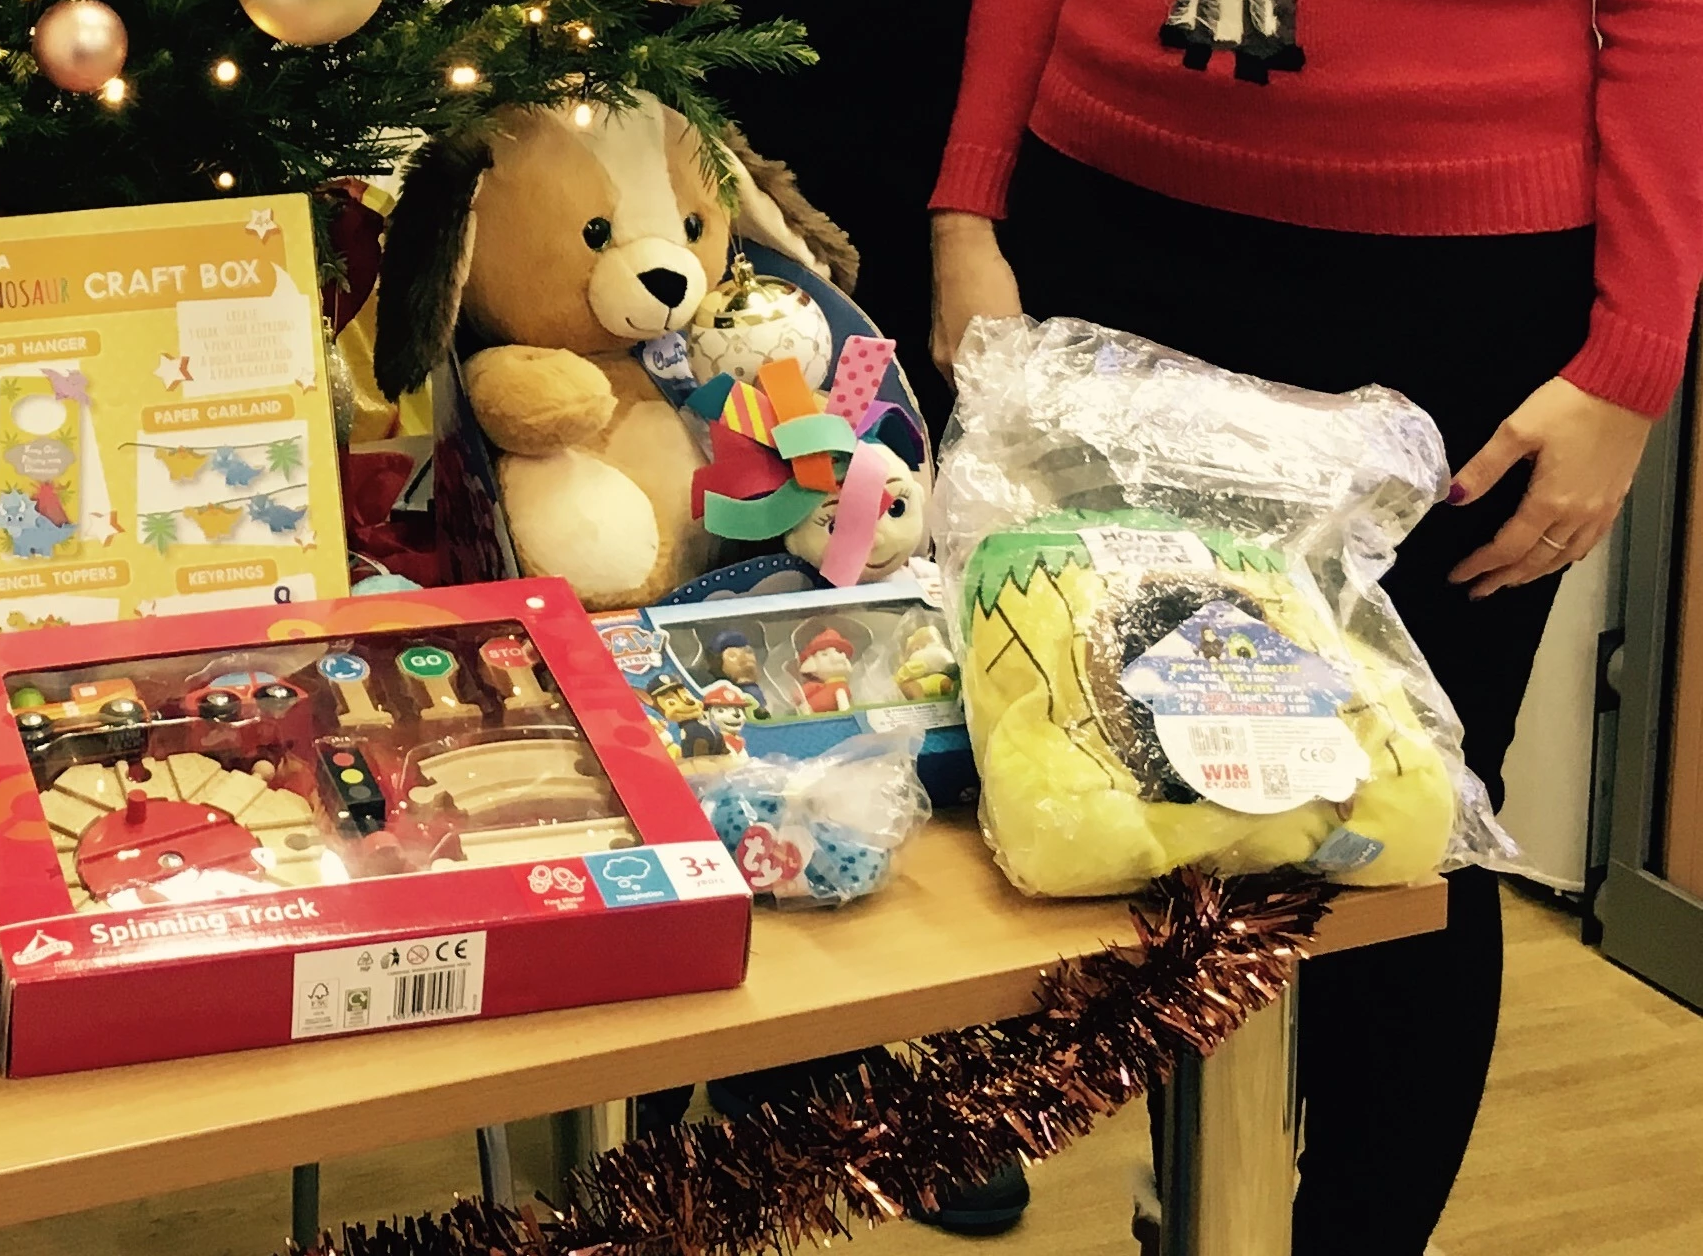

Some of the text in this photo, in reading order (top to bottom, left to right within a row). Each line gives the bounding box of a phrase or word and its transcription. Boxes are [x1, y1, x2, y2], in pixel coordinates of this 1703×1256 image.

[83, 264, 187, 300] CRAFT
[199, 258, 261, 289] BOX
[22, 336, 87, 355] HANGER
[154, 400, 282, 424] PAPER GARLAND
[1100, 531, 1179, 543] HOME
[52, 566, 117, 587] TOPPERS
[188, 565, 264, 586] KEYRINGS
[411, 654, 442, 667] GO
[488, 647, 525, 659] STO
[1201, 764, 1249, 781] WIN
[679, 856, 721, 877] 3+
[743, 835, 784, 887] ty
[90, 898, 320, 946] Spinning Track
